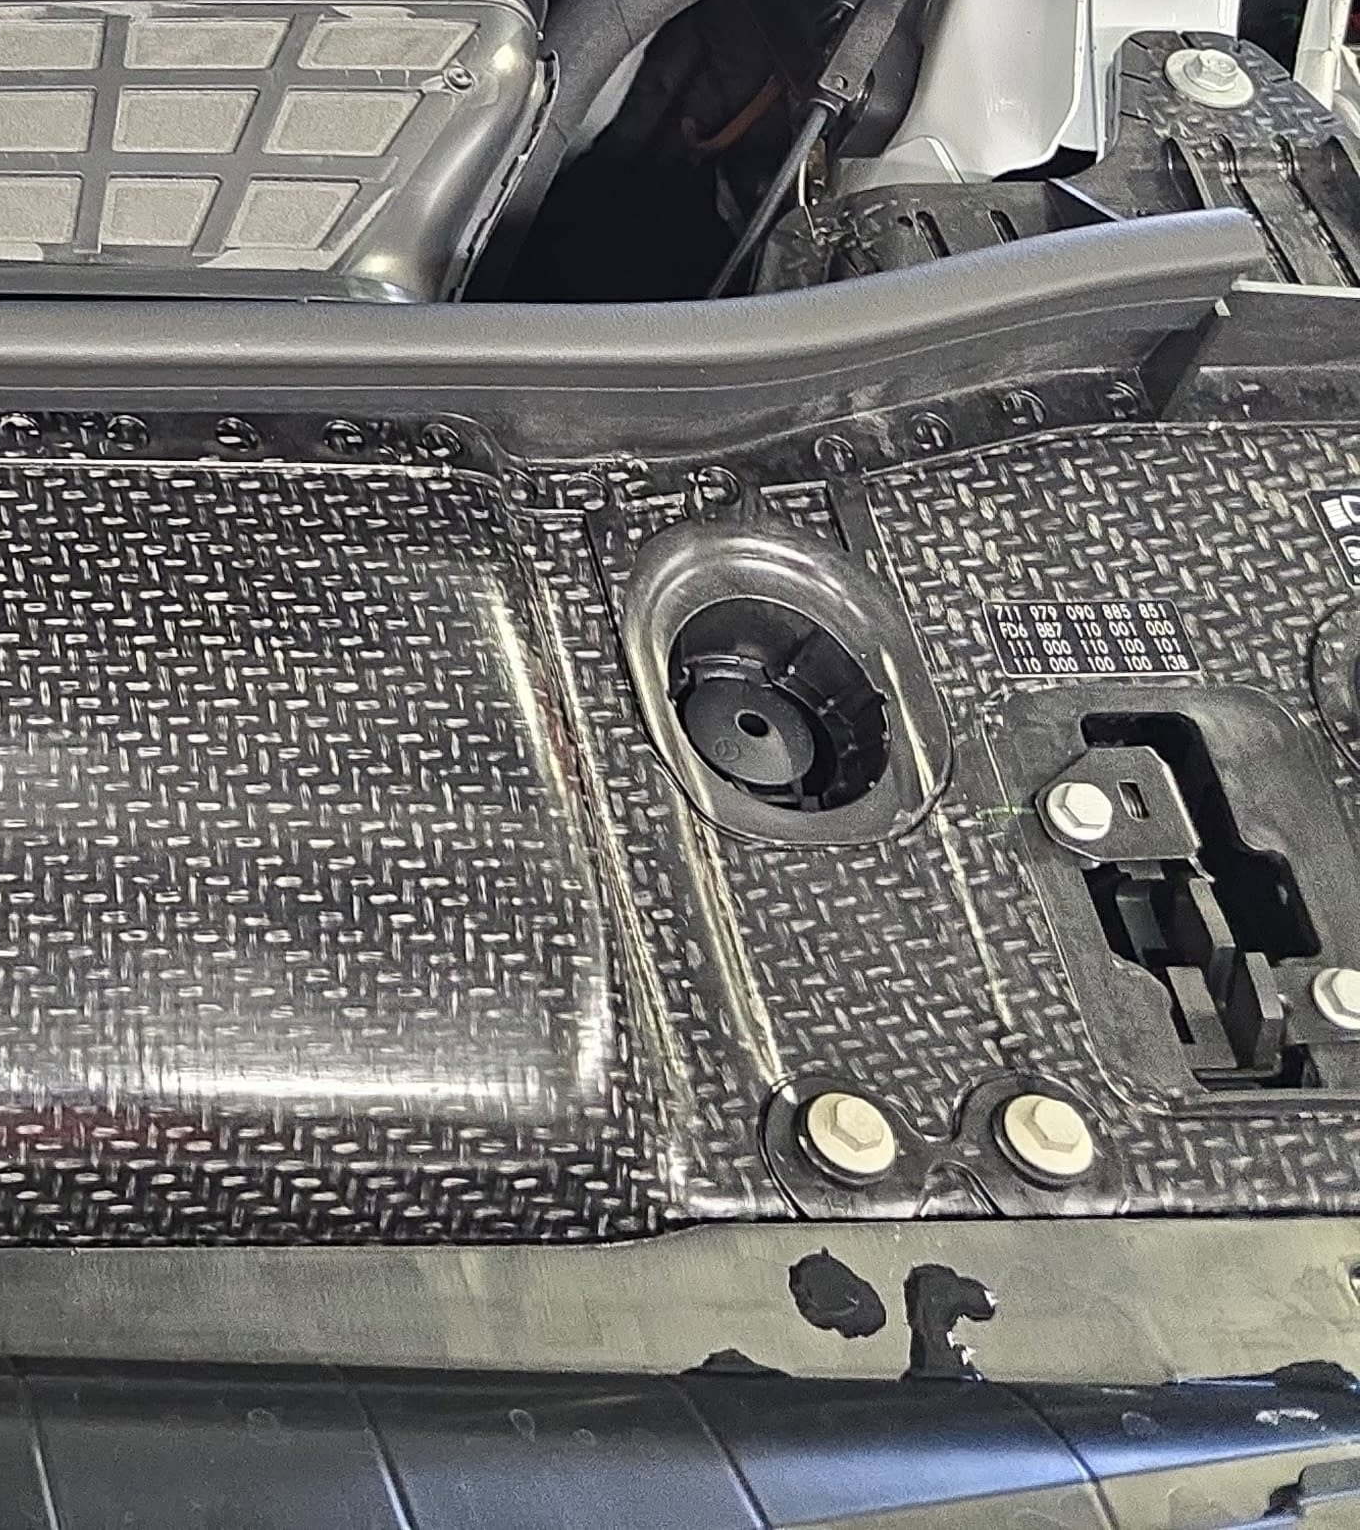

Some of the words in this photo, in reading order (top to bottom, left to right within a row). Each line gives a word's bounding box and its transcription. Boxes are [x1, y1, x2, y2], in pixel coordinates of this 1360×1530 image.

[992, 604, 1021, 621] 711
[1029, 605, 1057, 621] 979
[1065, 604, 1096, 620] 090
[1102, 603, 1132, 620] 885
[1138, 602, 1167, 619] 851
[999, 622, 1028, 639] FD6
[1073, 622, 1101, 638] 110
[1109, 620, 1137, 637] 001
[1145, 620, 1175, 636] 000
[1007, 639, 1034, 656] 111
[1042, 639, 1072, 656] 000
[1080, 639, 1109, 655] 110
[1117, 638, 1146, 654] 100
[1153, 637, 1181, 653] 101
[1013, 657, 1041, 673] 110
[1049, 656, 1079, 672] 000
[1088, 656, 1116, 672] 100
[1124, 655, 1153, 671] 100
[1161, 654, 1190, 670] 138
